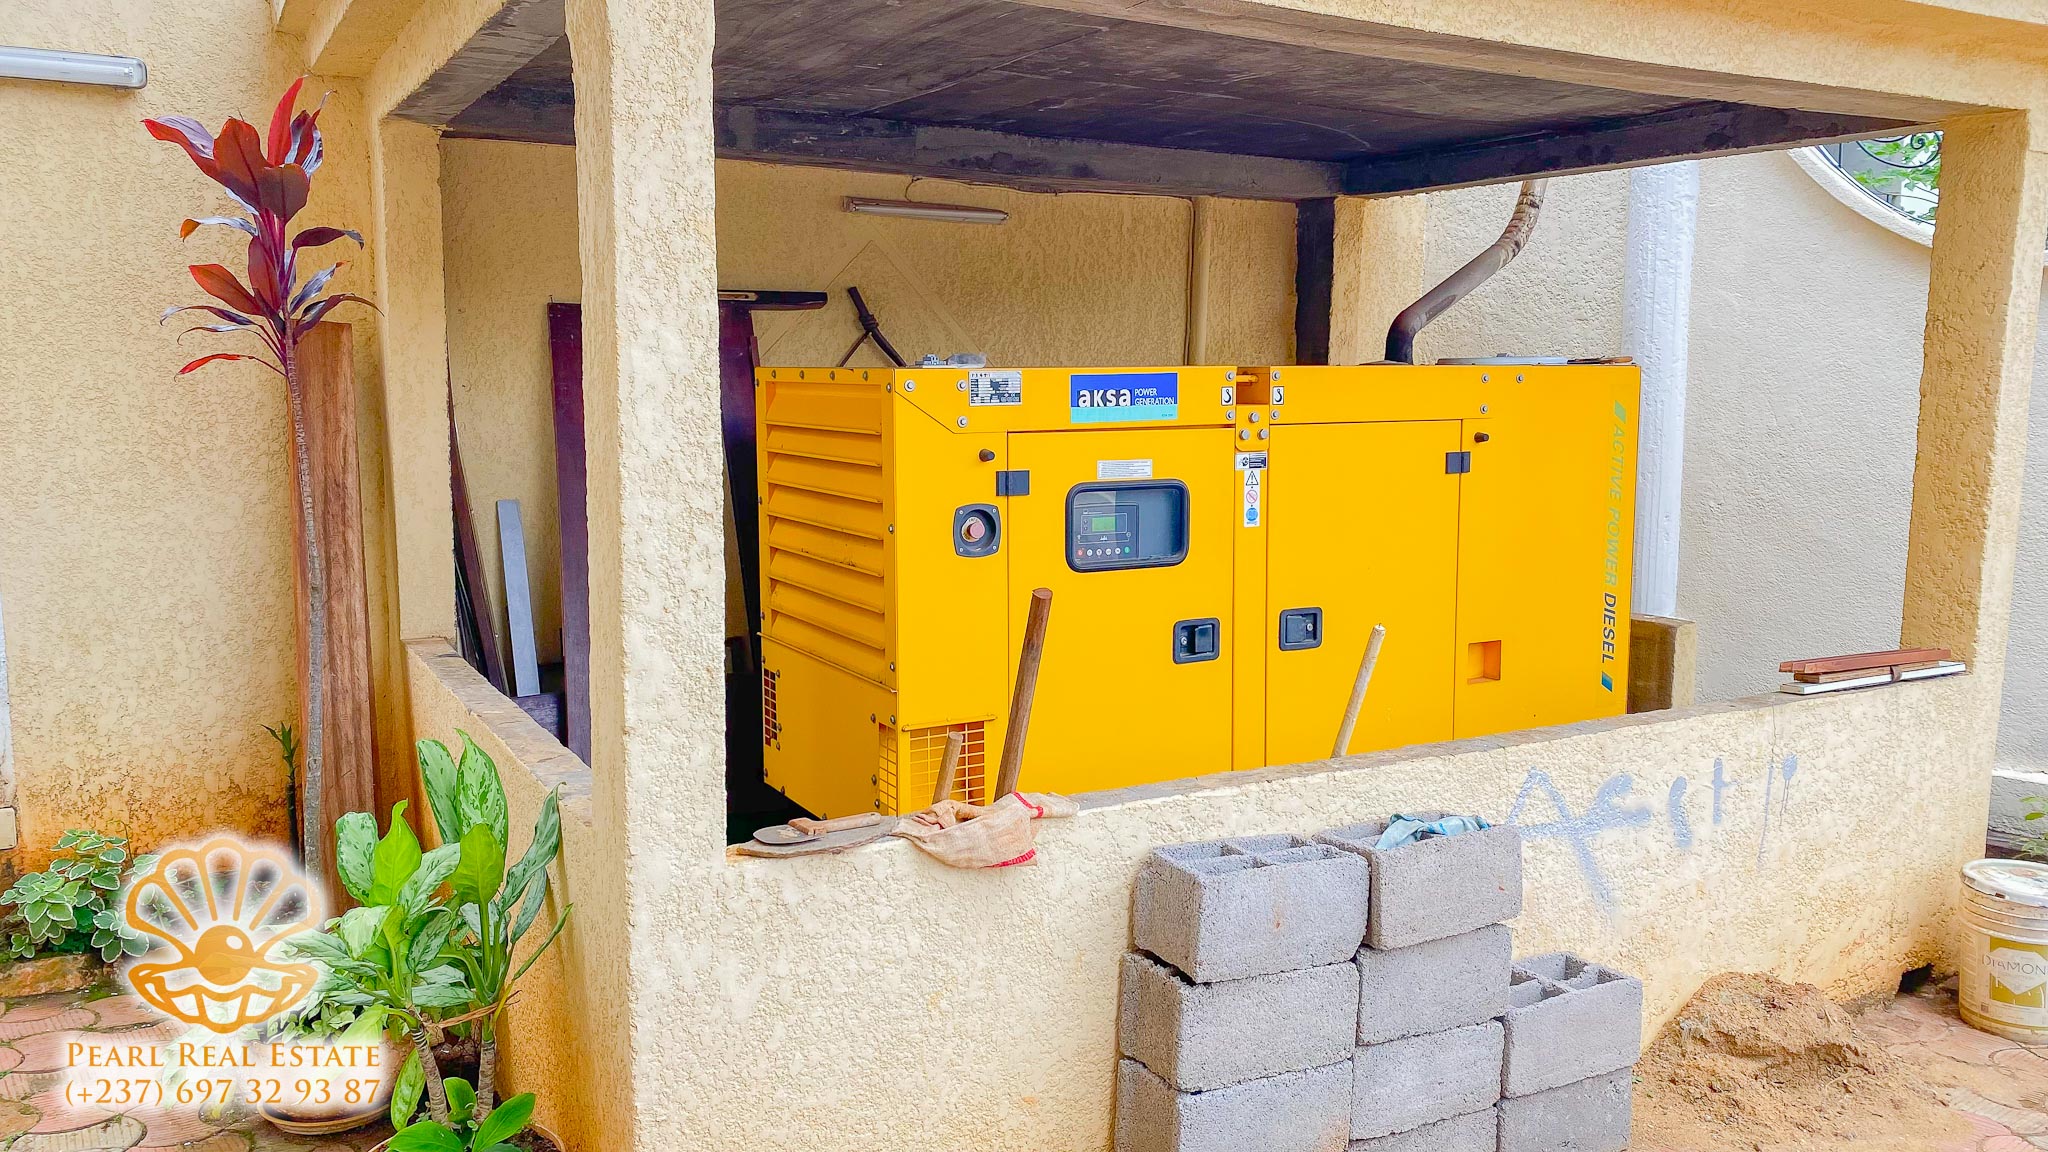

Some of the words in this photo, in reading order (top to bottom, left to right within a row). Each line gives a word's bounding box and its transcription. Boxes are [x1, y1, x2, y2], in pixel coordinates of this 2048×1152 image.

[1078, 388, 1131, 407] aksa
[1134, 388, 1158, 397] POWER
[1134, 396, 1175, 406] GENERATION
[1609, 423, 1625, 503] ACTIVE
[1605, 506, 1621, 586] POWER
[1601, 592, 1617, 664] DIESEL
